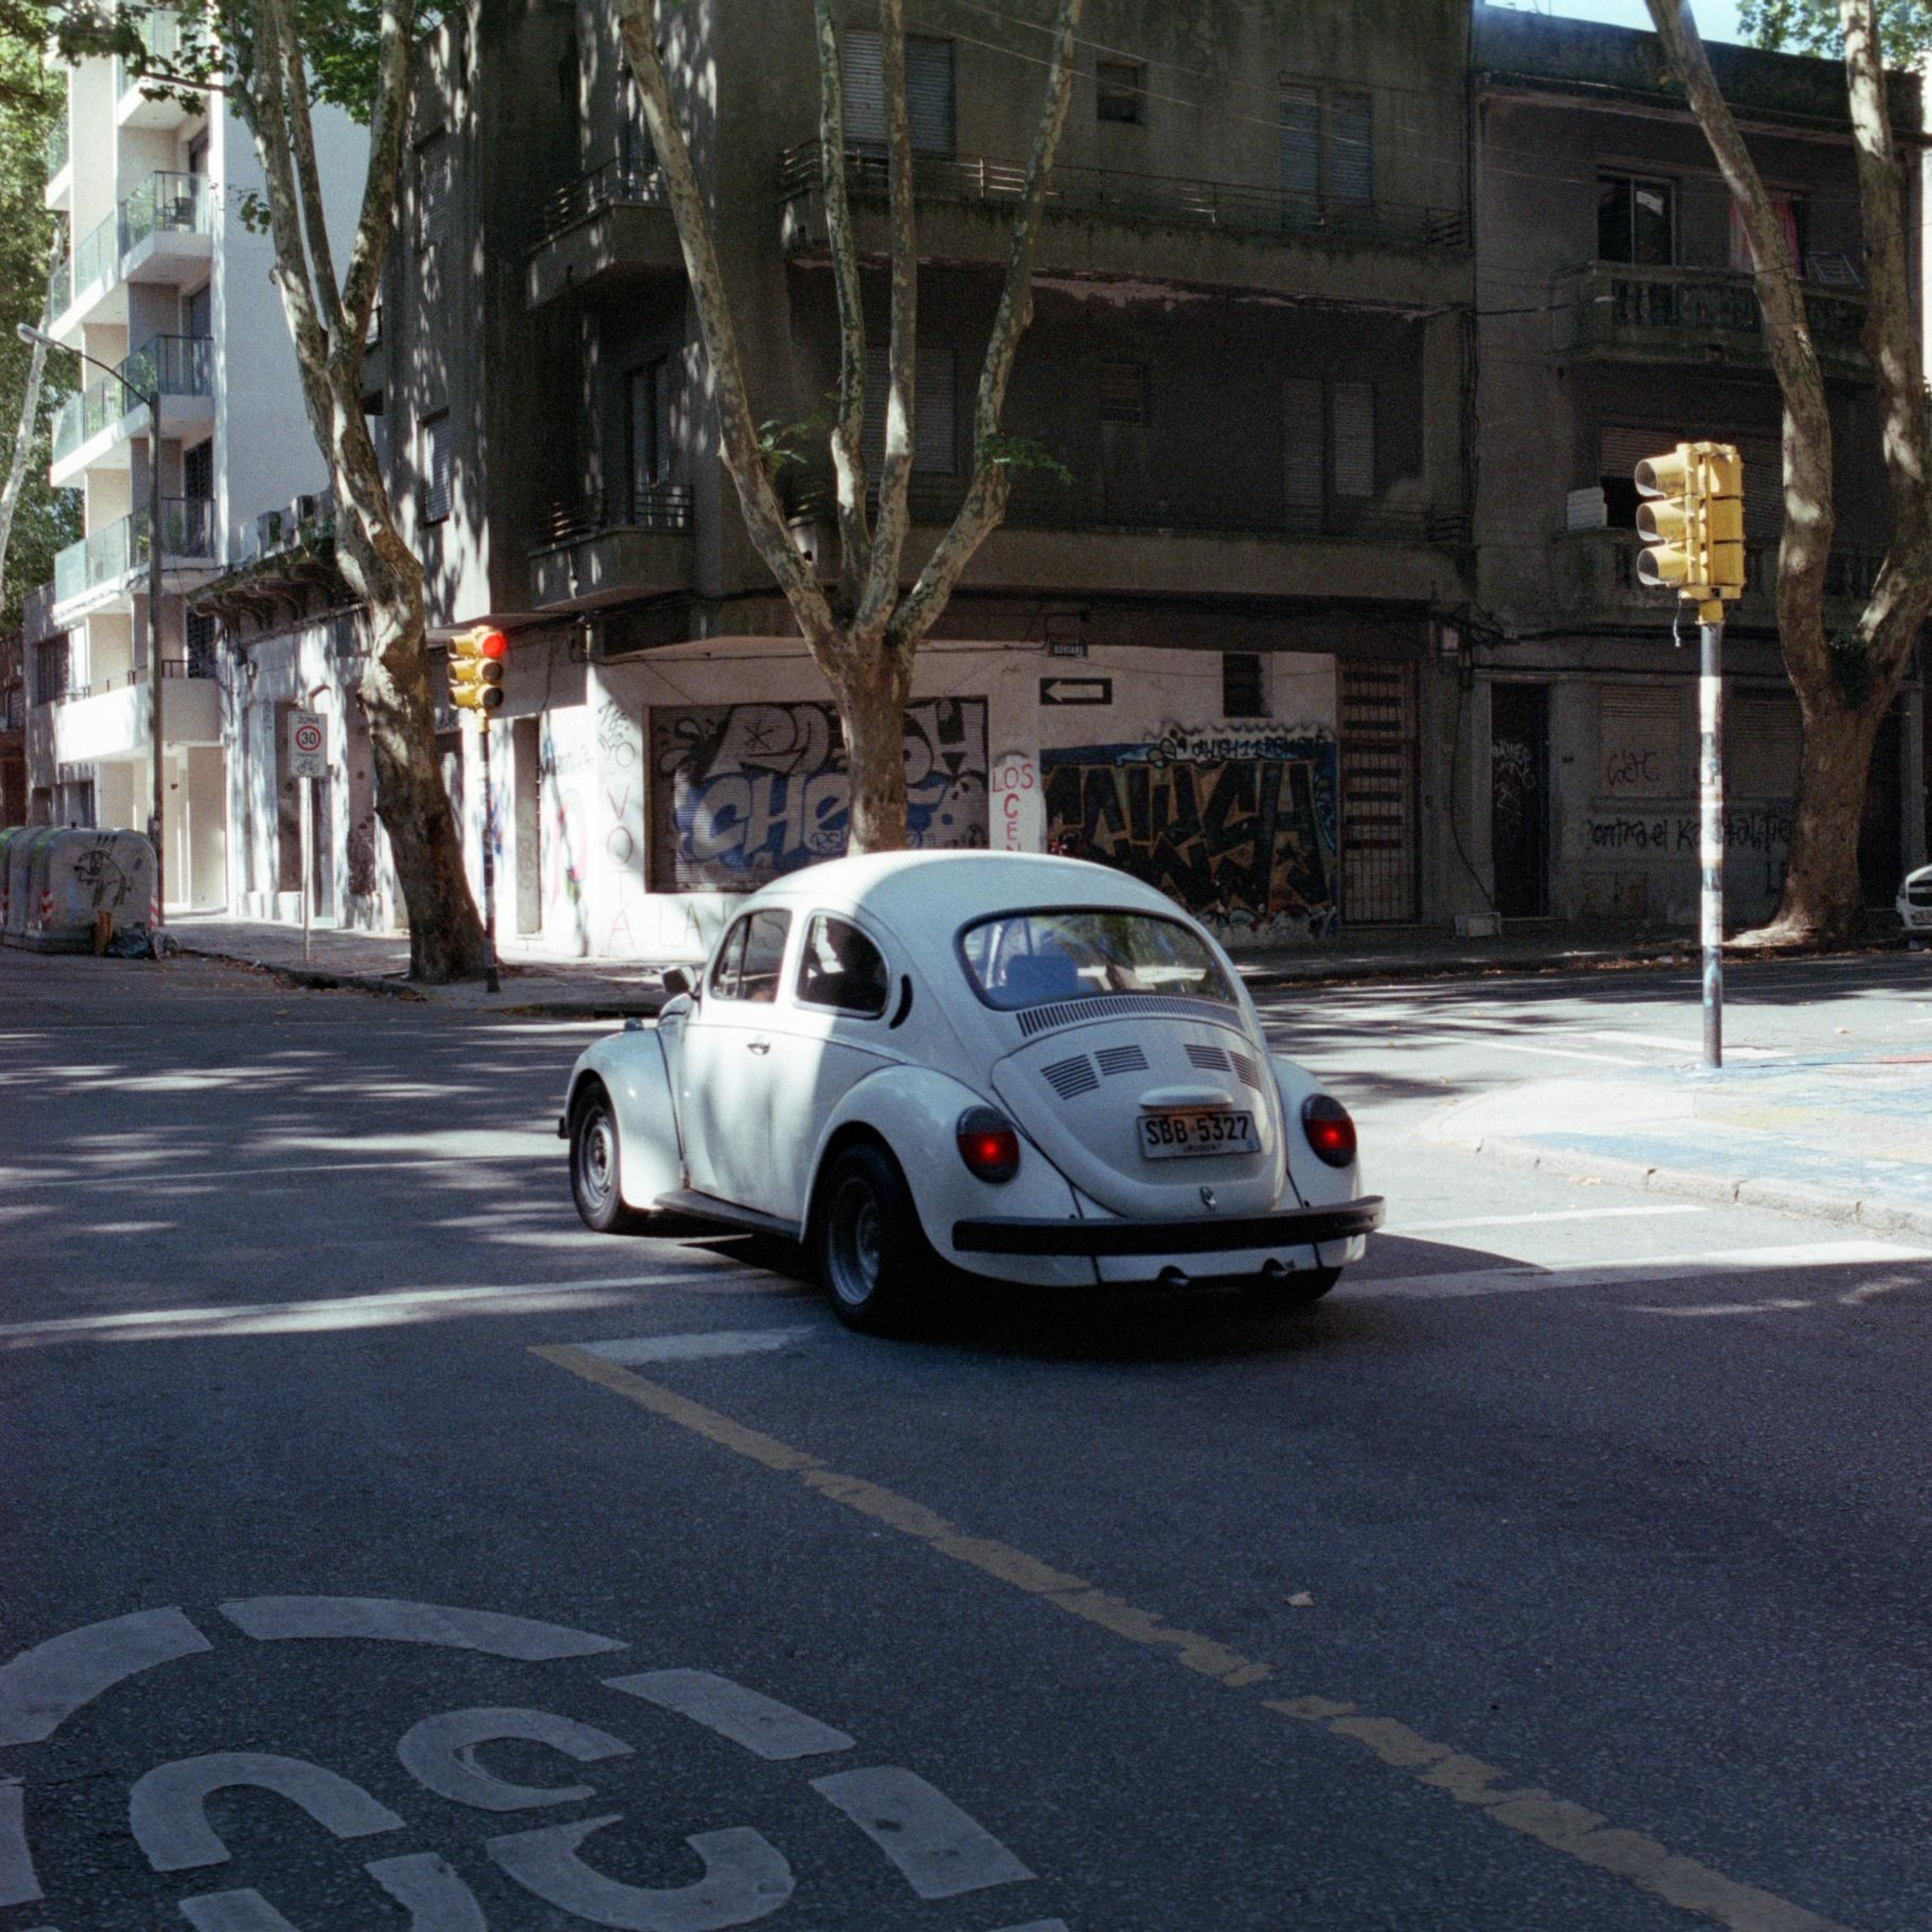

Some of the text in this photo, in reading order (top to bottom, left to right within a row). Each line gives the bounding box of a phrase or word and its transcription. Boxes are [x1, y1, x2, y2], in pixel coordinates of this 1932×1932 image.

[301, 731, 316, 745] 30
[992, 762, 1034, 793] LOS
[1146, 1115, 1249, 1145] SBB 5327
